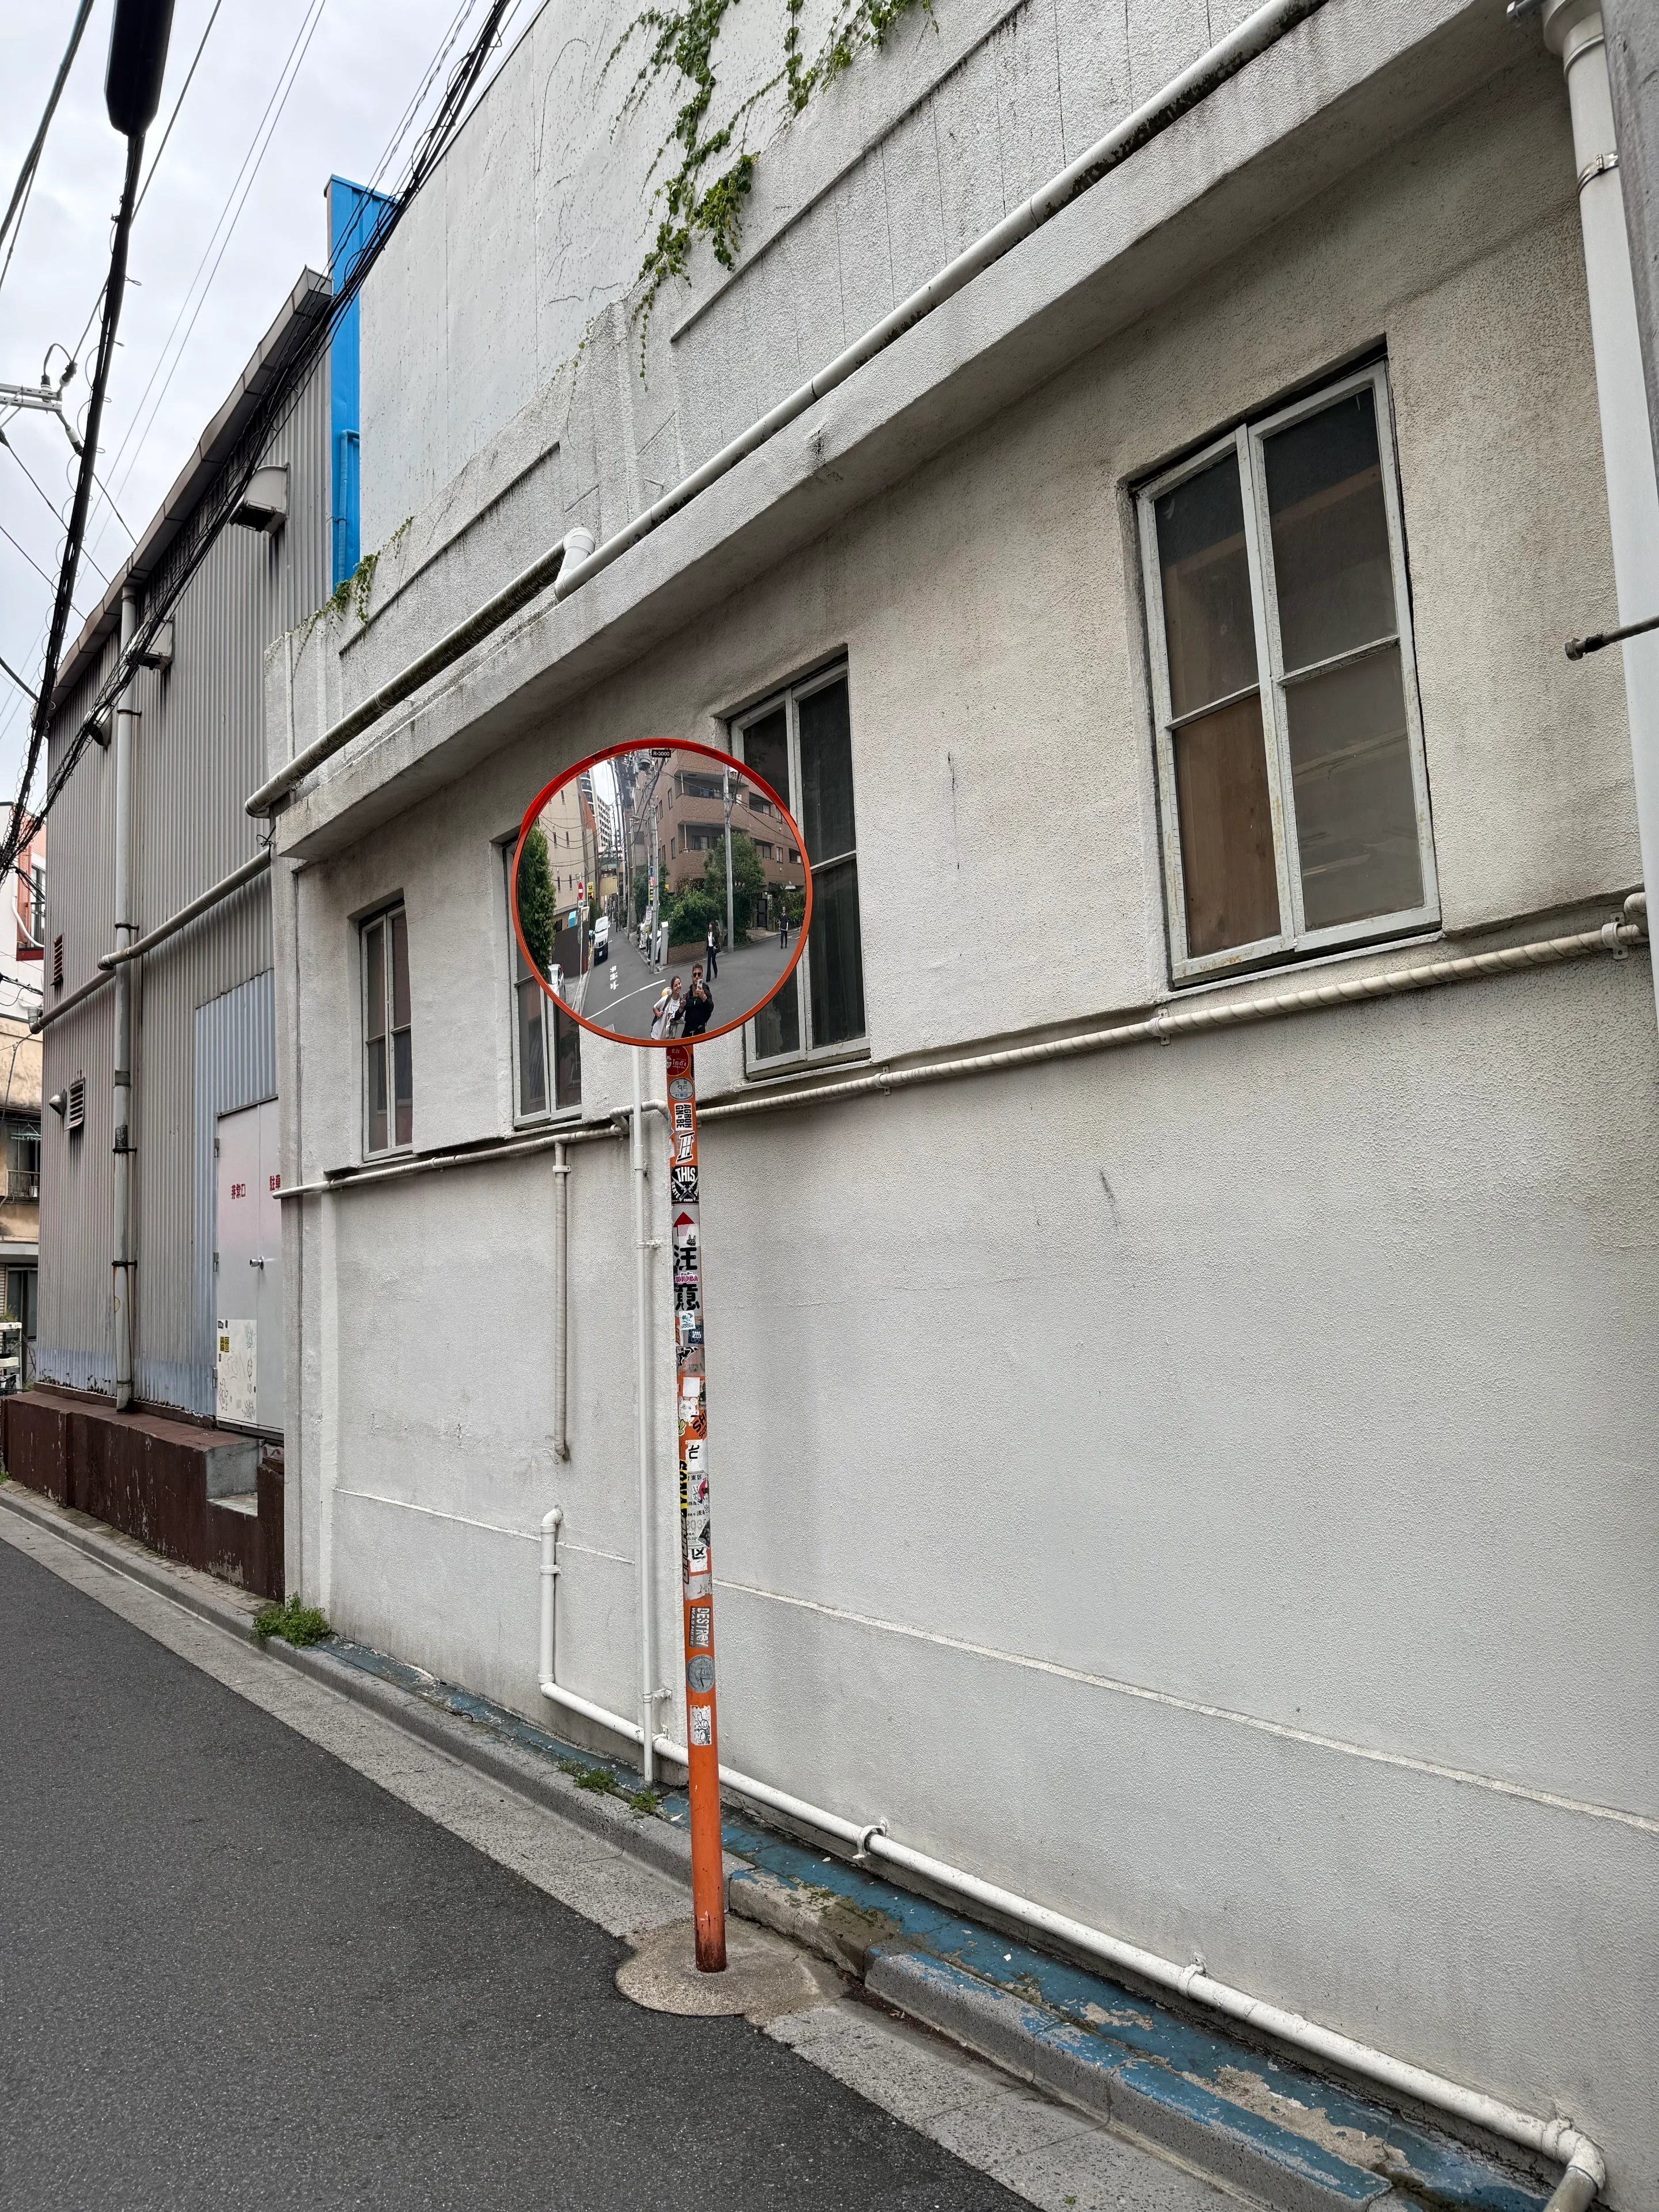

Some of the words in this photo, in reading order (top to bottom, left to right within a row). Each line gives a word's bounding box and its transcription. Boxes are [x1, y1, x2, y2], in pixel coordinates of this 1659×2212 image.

[684, 1104, 692, 1128] AGROH
[675, 1166, 695, 1182] THIS
[231, 1183, 246, 1199] 非常口
[695, 1608, 710, 1647] DESTROY
